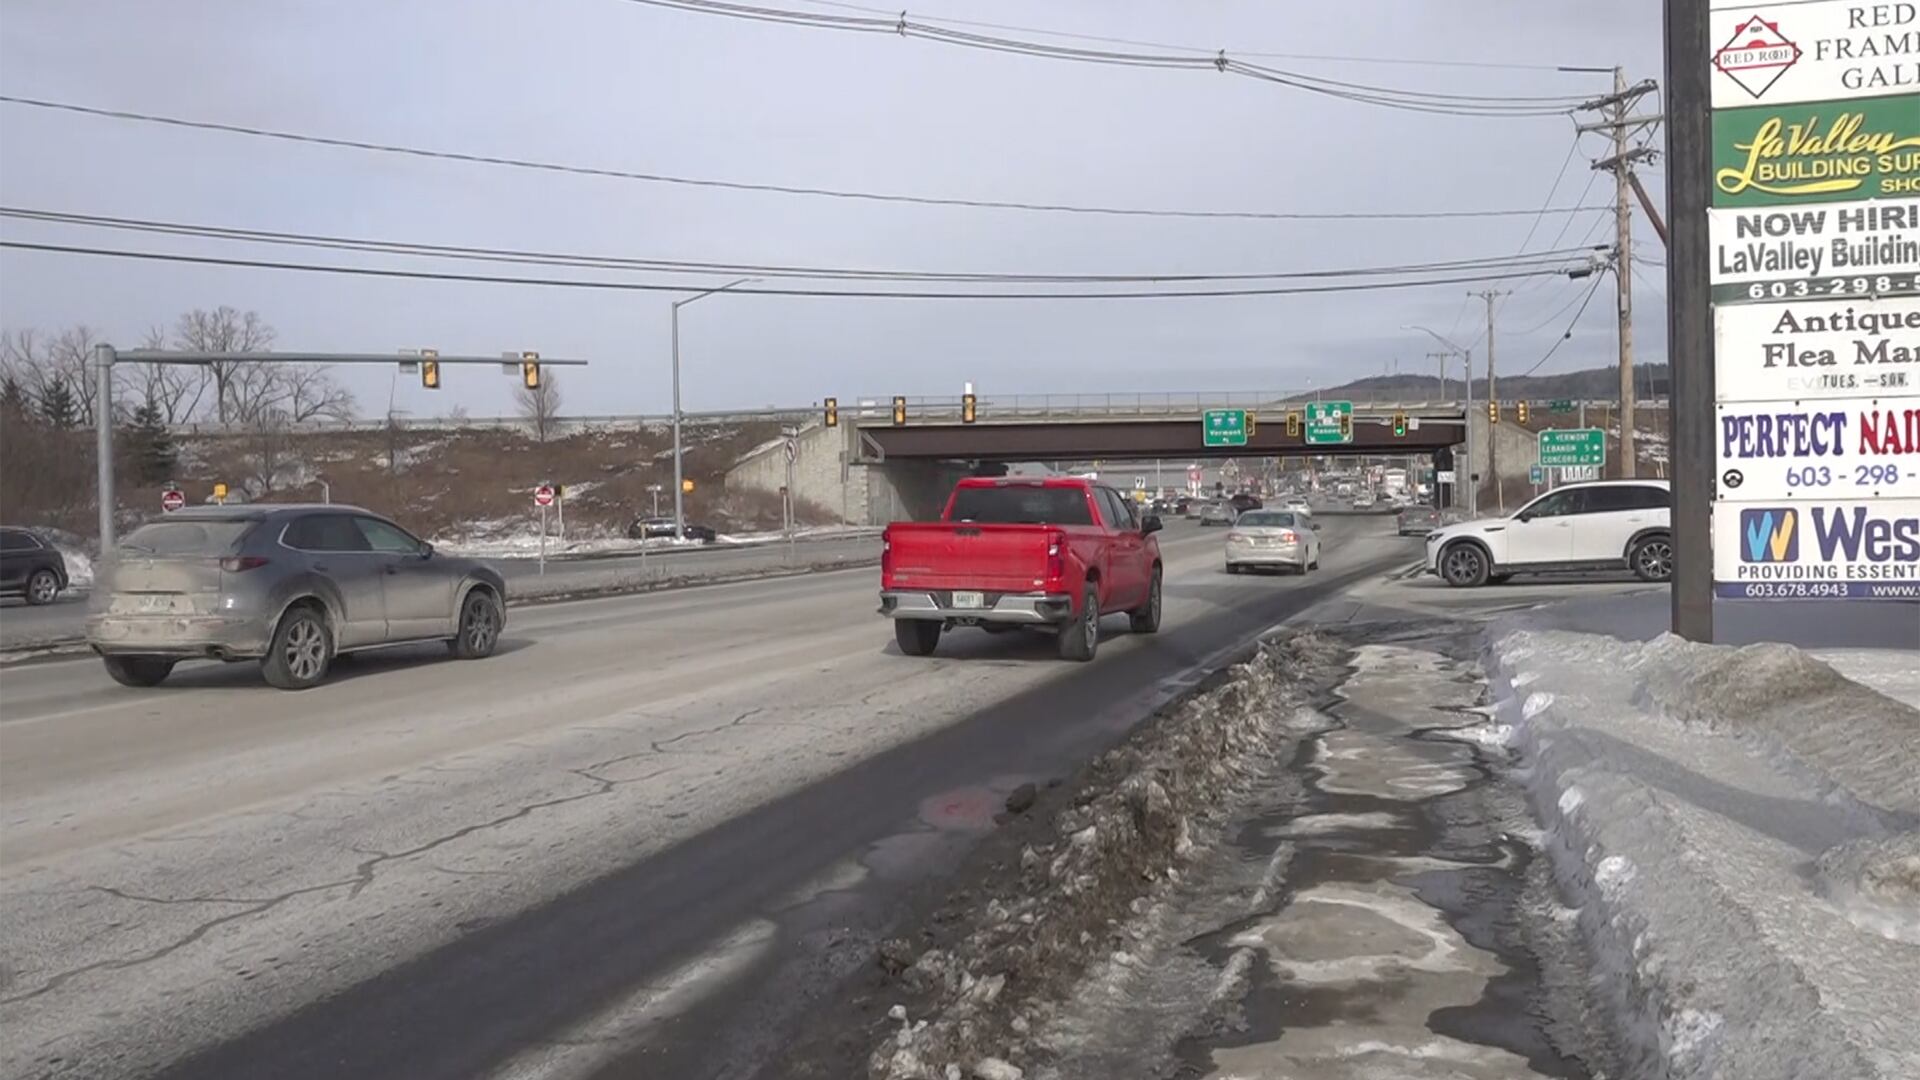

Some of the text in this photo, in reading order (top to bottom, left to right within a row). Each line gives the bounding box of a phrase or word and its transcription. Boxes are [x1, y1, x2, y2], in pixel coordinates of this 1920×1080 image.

[1848, 3, 1916, 29] RED
[1723, 52, 1754, 65] RED
[1716, 113, 1896, 193] LaValley
[1758, 156, 1871, 181] BUILDING
[1736, 211, 1826, 239] NOW
[1718, 234, 1920, 276] LaValley Buildin
[1772, 307, 1920, 335] Antique
[1762, 342, 1837, 368] Flea
[1556, 433, 1590, 442] VERMONT
[1721, 411, 1848, 458] PERFECT
[1542, 445, 1577, 454] LEBANON
[1542, 455, 1578, 464] CONCORD
[1786, 466, 1831, 486] 603
[1855, 464, 1899, 486] 298
[1738, 563, 1920, 580] PROVIDING ESSENT
[1745, 584, 1920, 597] 603.678.4943 www.
